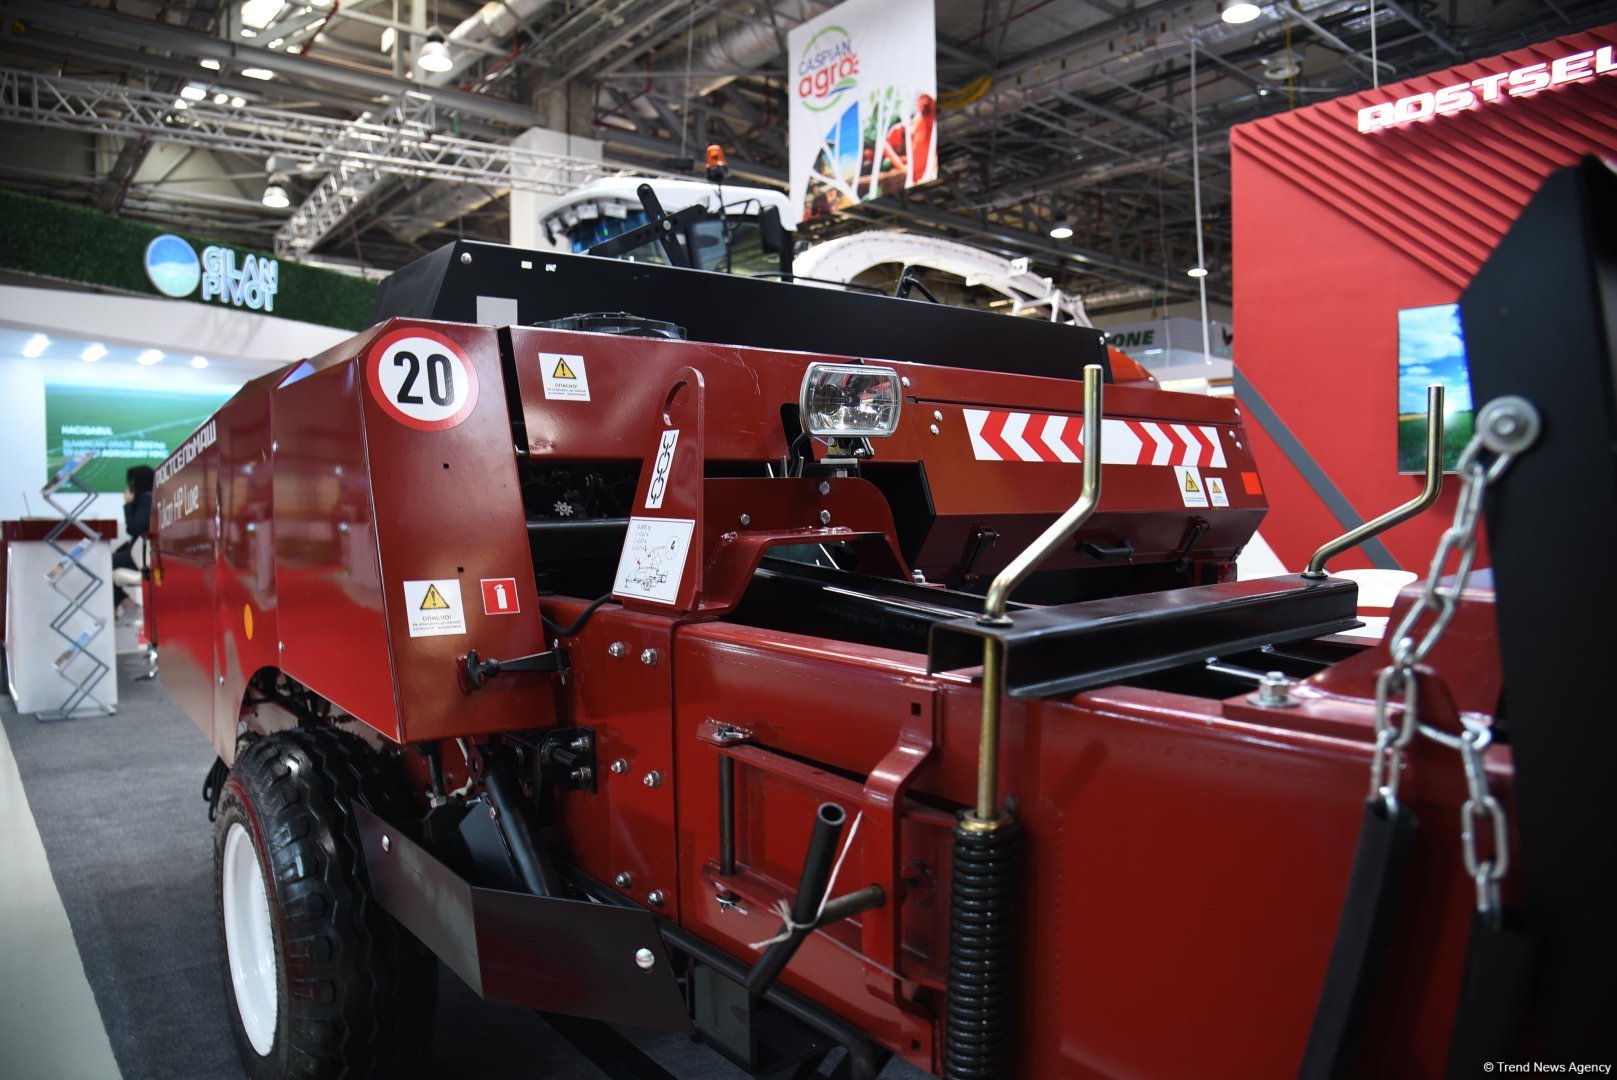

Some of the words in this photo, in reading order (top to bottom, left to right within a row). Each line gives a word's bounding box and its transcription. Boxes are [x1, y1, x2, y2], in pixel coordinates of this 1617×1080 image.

[798, 39, 851, 76] CASPIAN
[798, 56, 857, 98] agro
[203, 246, 278, 294] GILAN
[202, 271, 274, 312] PIVOT
[393, 351, 455, 406] 20
[155, 419, 217, 488] РОСТСЕЛЬМАШ
[173, 487, 183, 522] HP
